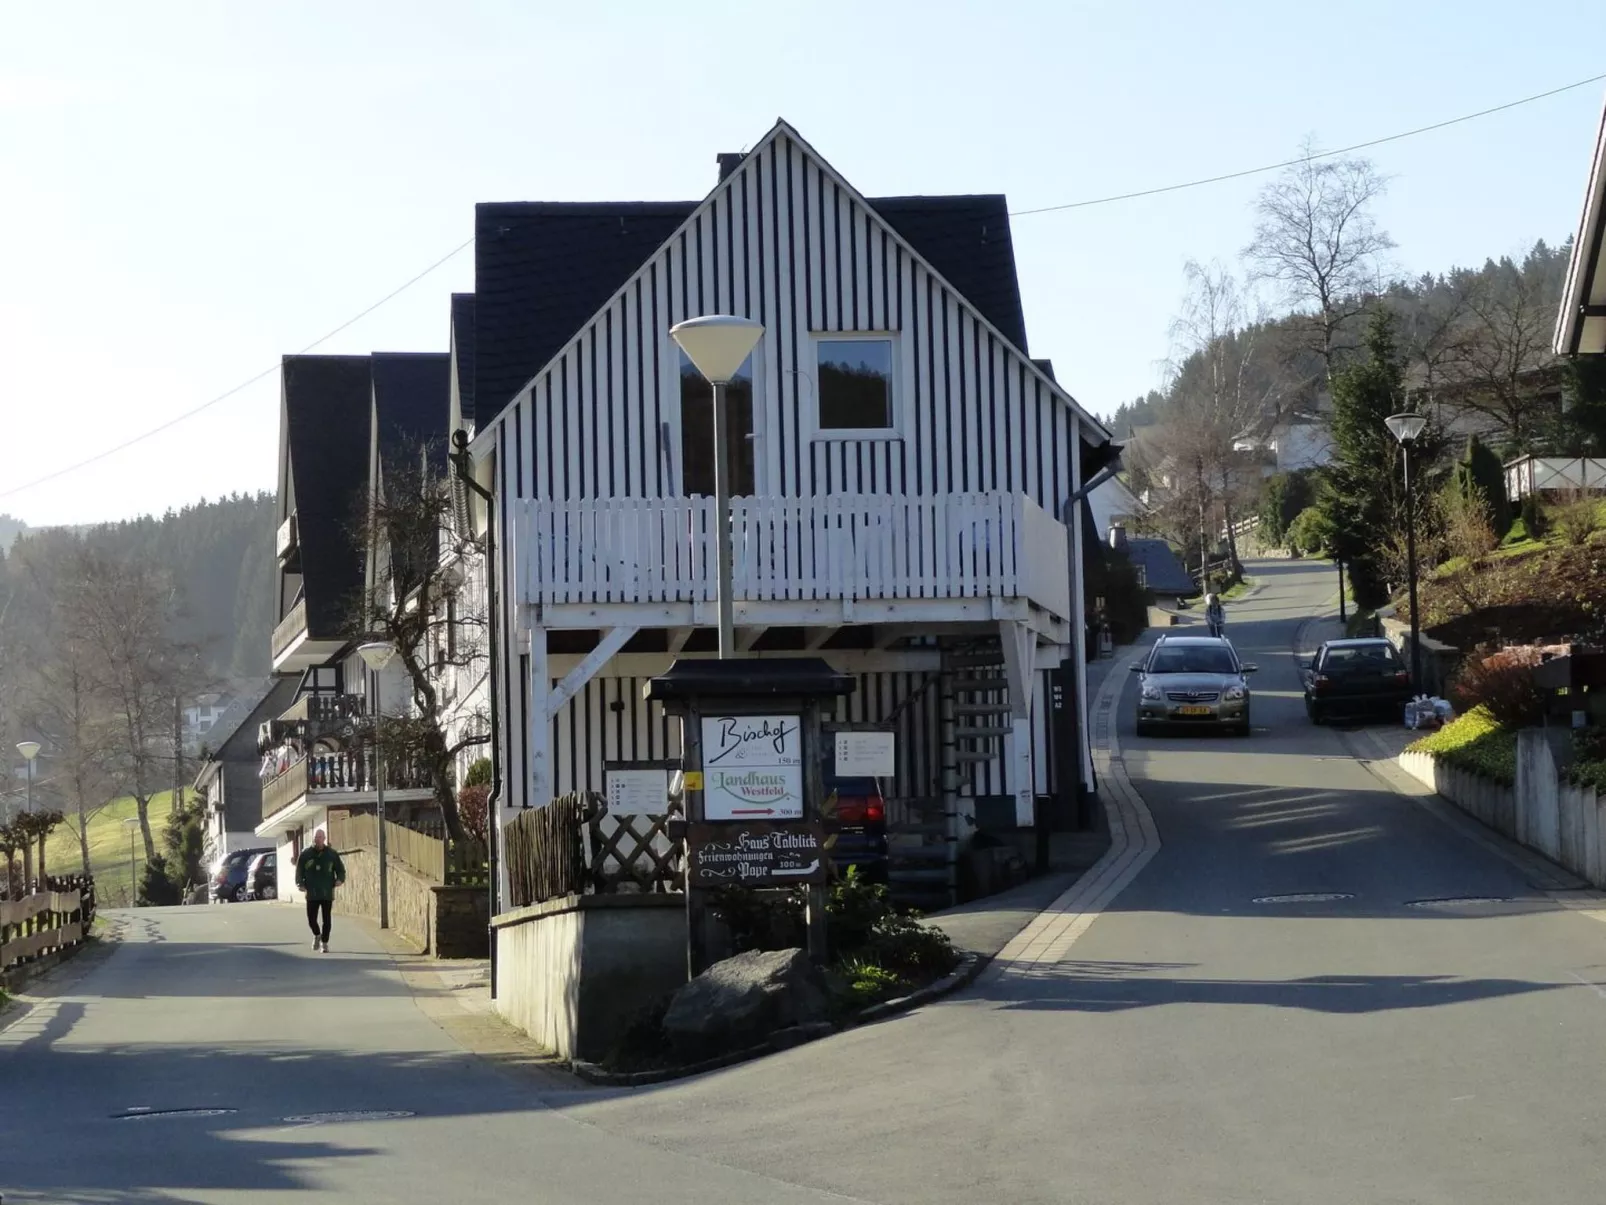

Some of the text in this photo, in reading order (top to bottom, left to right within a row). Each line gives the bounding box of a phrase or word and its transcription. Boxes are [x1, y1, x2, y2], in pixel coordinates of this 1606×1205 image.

[709, 717, 798, 763] Bischof
[711, 771, 786, 789] Landhaus
[741, 786, 784, 796] Westfeld
[735, 831, 770, 851] Haus
[770, 830, 817, 849] Talblick
[698, 851, 773, 865] Ferienwohnungen
